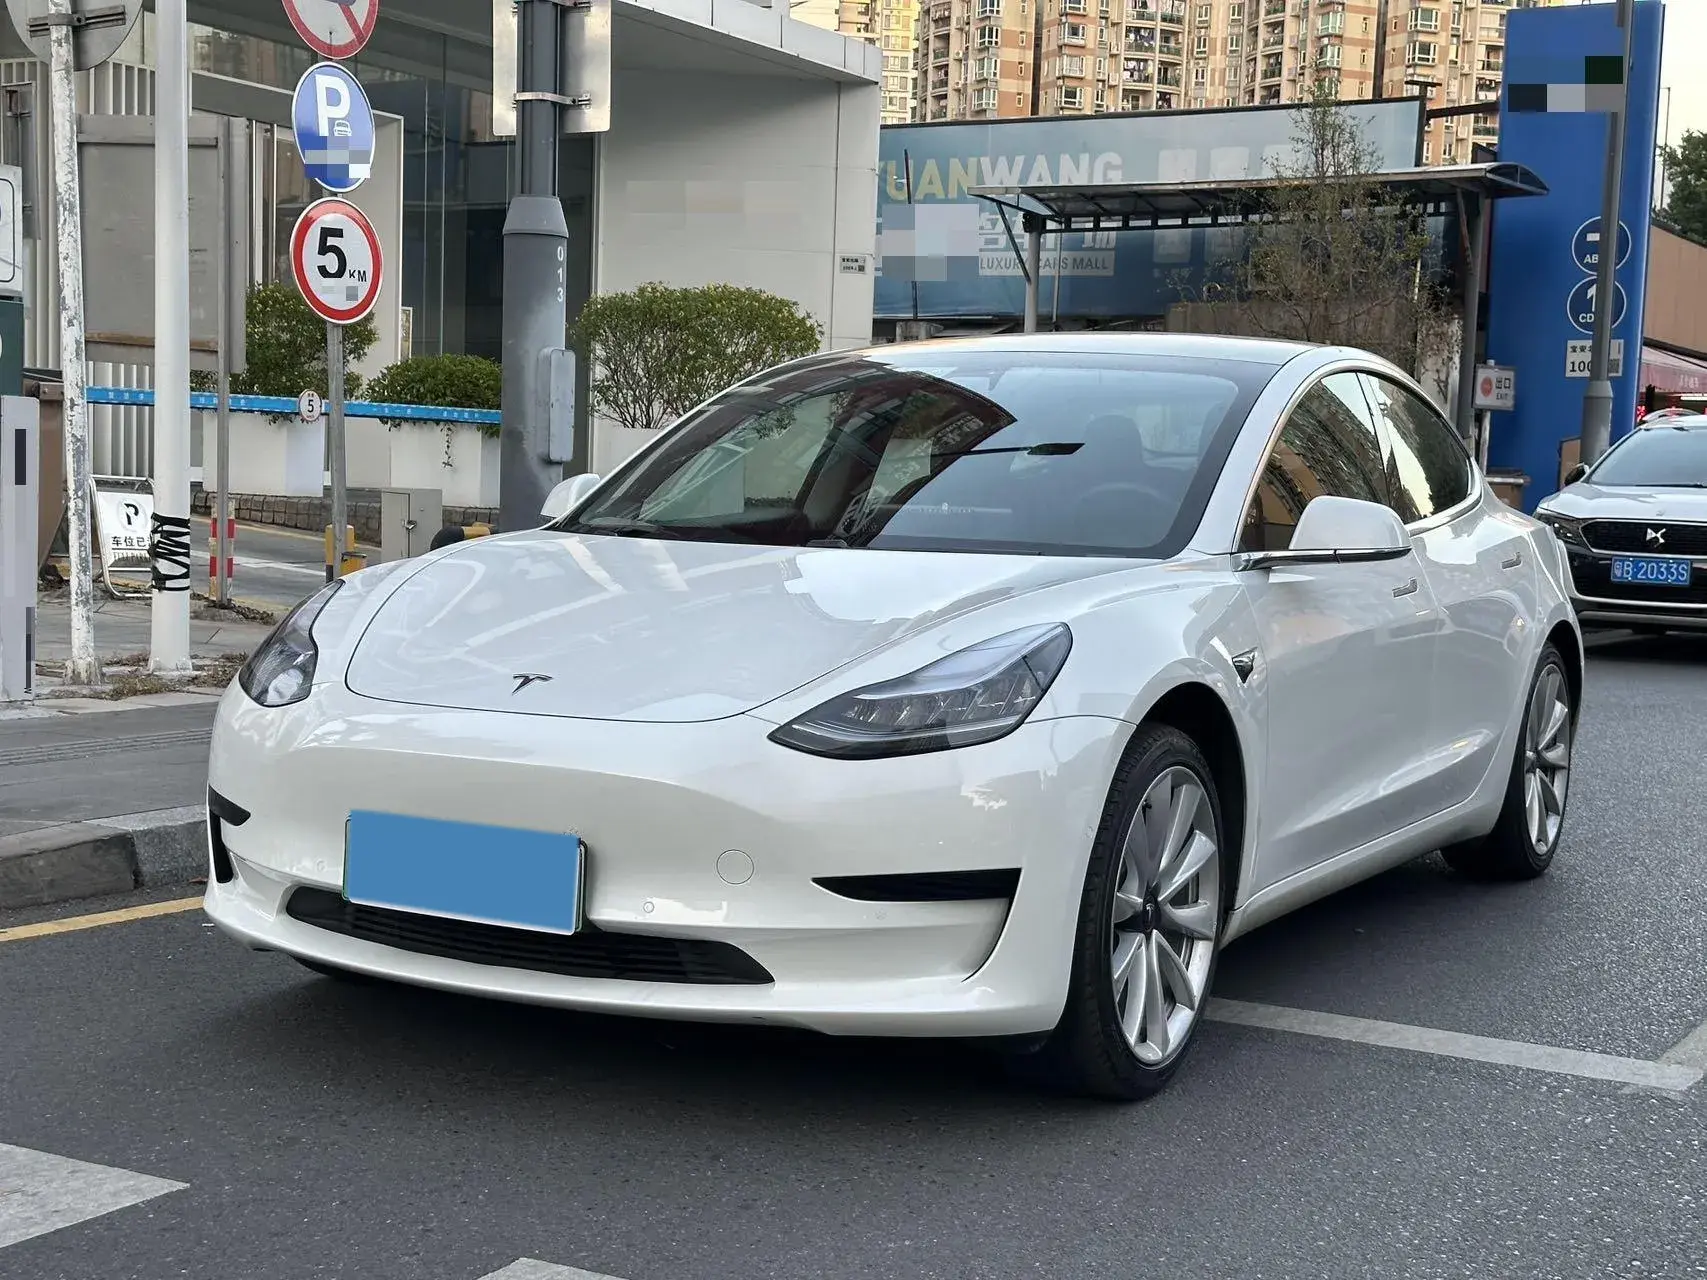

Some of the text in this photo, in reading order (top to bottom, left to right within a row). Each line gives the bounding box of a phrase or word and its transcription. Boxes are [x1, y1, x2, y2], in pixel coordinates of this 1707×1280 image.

[315, 74, 351, 136] P
[317, 227, 367, 282] 5 KM
[1072, 256, 1109, 270] MALL
[1495, 377, 1511, 389] 出口
[307, 399, 314, 413] 5
